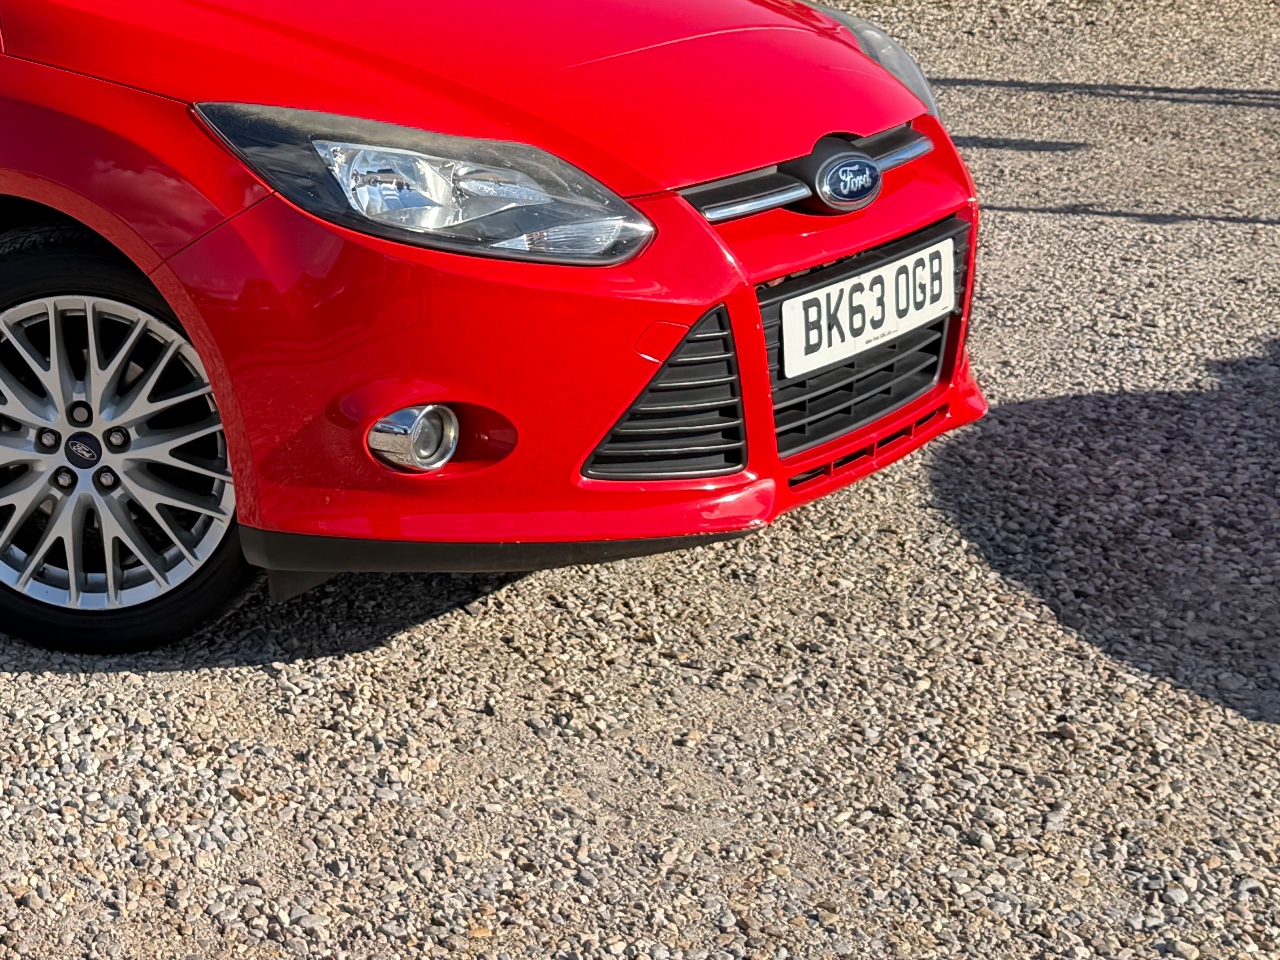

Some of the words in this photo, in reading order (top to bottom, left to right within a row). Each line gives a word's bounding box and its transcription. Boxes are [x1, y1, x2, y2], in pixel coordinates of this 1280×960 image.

[838, 164, 872, 195] Ford
[801, 274, 886, 357] BK63
[894, 249, 943, 320] OGB
